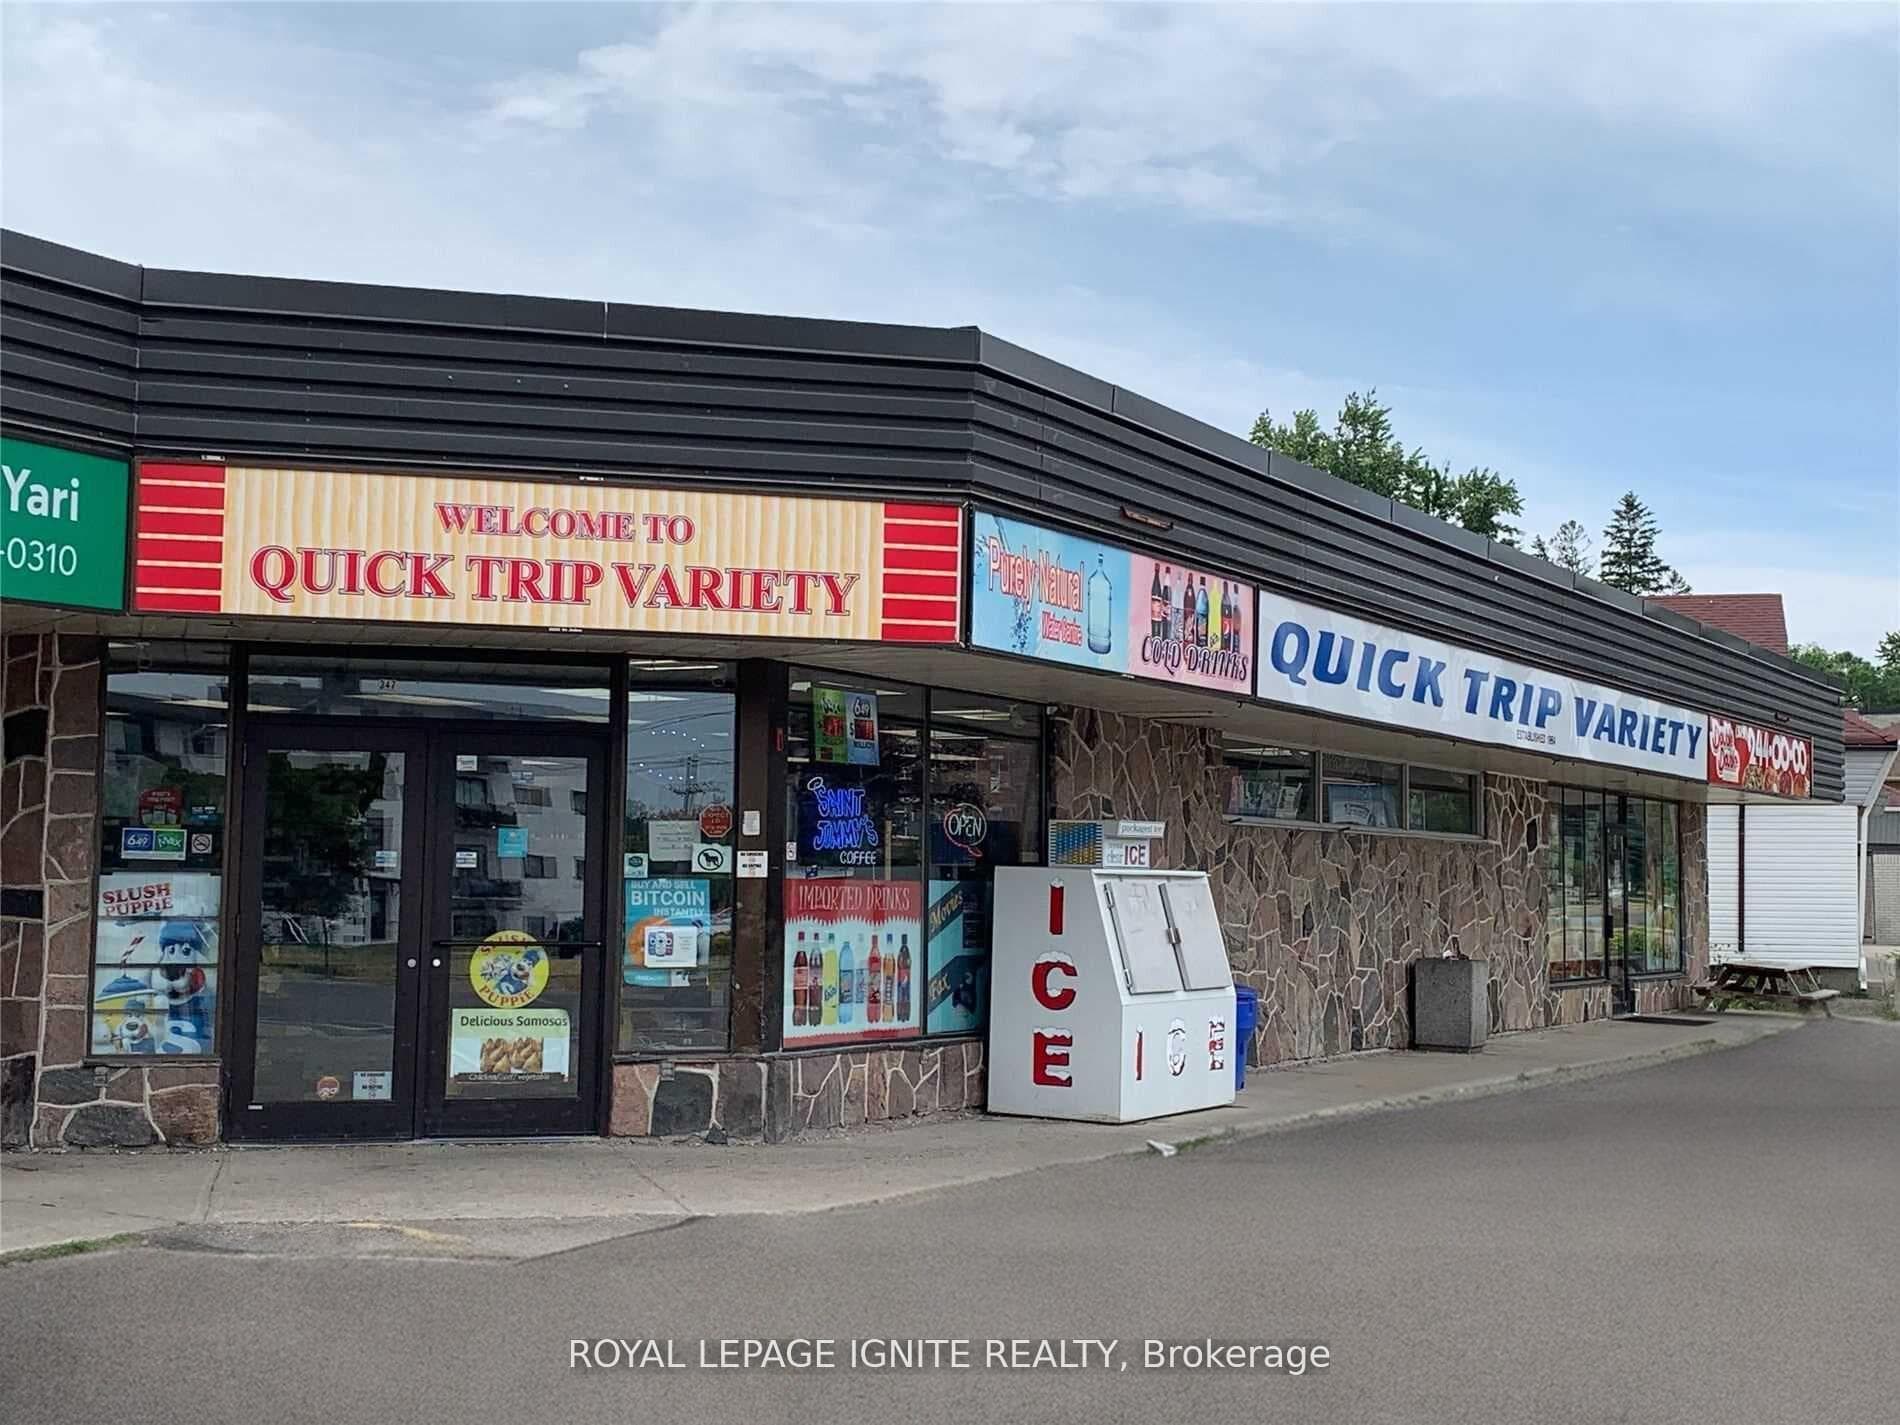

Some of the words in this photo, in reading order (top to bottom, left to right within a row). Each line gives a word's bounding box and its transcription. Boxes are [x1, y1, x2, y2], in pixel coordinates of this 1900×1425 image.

[2, 464, 80, 522] Yari
[434, 502, 636, 542] WELCOME
[642, 513, 696, 546] TO
[249, 545, 455, 603] QUICK
[466, 554, 605, 606] TRIP
[611, 562, 861, 617] VARIETY
[987, 535, 1036, 613] Purely
[1038, 549, 1085, 613] Natural
[1141, 634, 1182, 675] COLD
[1184, 643, 1248, 681] DRINKS
[1270, 622, 1446, 706] QUICK
[1464, 668, 1562, 729] TRIP
[1574, 696, 1703, 760] VARIETY
[815, 787, 866, 818] SAINT
[812, 817, 879, 851] JIMMY'S
[948, 814, 983, 839] OPEN
[839, 851, 878, 866] COFFEE
[1124, 844, 1147, 866] ICE
[102, 881, 171, 905] SLUSH
[631, 880, 651, 889] BUY
[651, 880, 672, 889] AND
[674, 880, 696, 889] SELL
[105, 899, 174, 917] PUPPIE
[631, 890, 705, 906] BITCOIN
[799, 886, 863, 911] IMPORTED
[866, 887, 911, 912] DRINKS
[653, 908, 705, 916] INSTANTLY
[1031, 876, 1079, 1088] ICE
[476, 985, 536, 1007] PUPPIE
[460, 1015, 514, 1027] Delicious
[516, 1015, 568, 1027] Samosas
